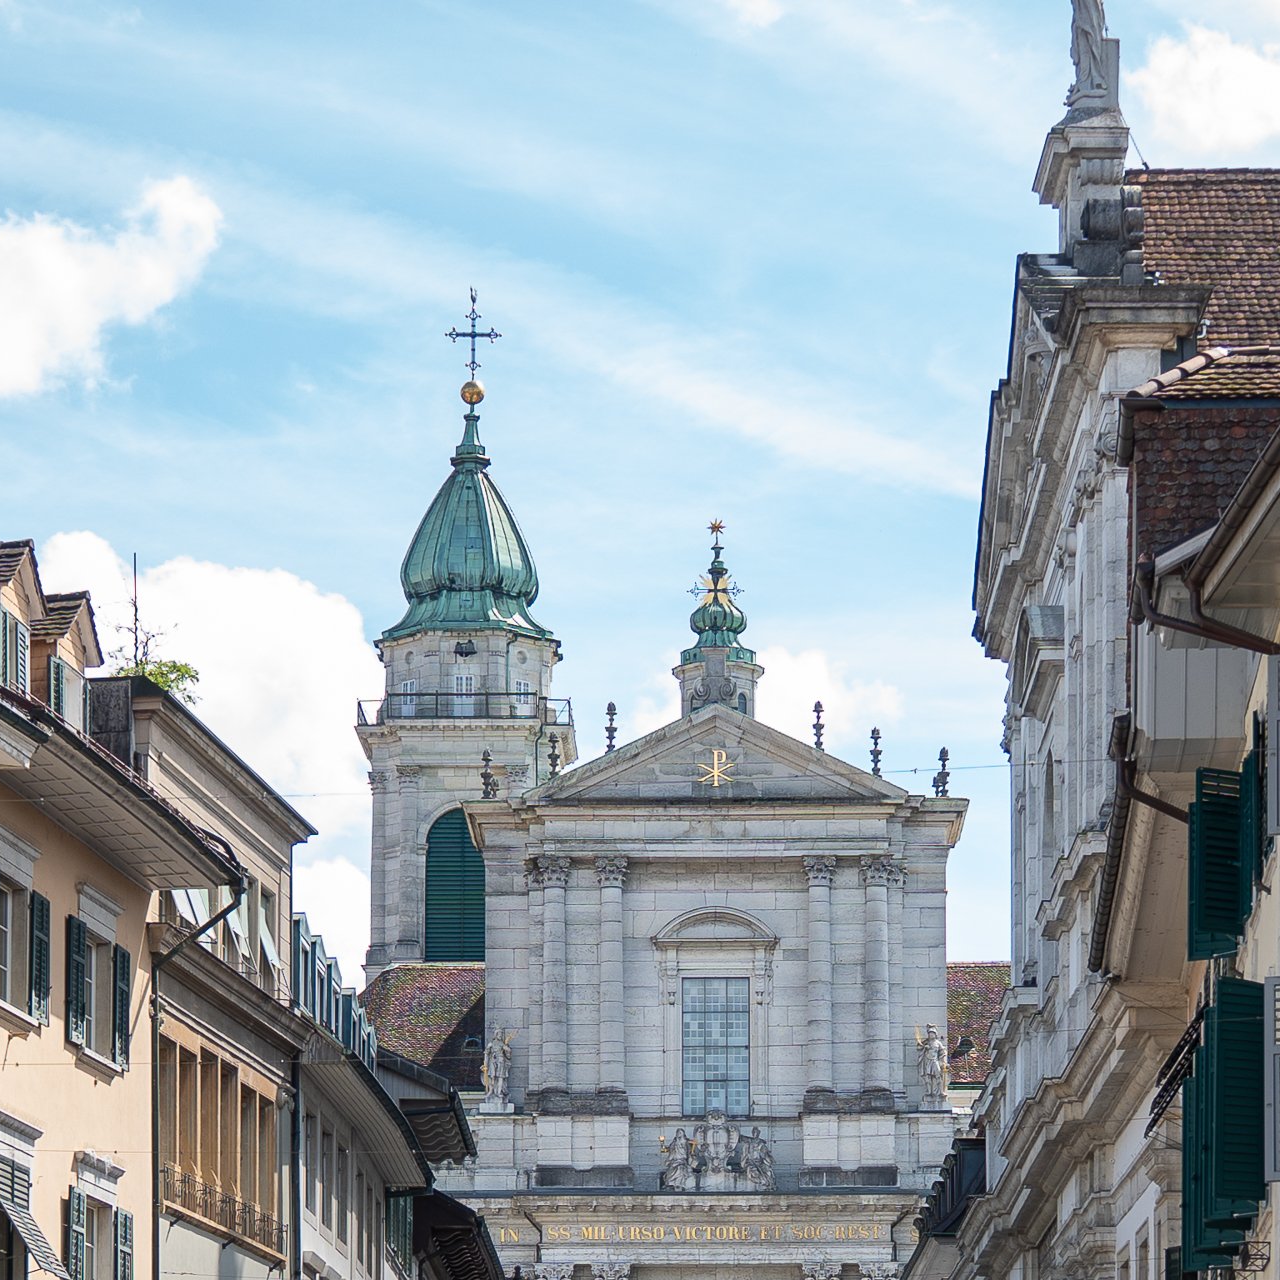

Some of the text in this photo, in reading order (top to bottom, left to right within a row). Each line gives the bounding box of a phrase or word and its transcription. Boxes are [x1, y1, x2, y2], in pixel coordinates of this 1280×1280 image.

[500, 1227, 519, 1242] IN
[674, 1226, 751, 1240] VICTORE
[760, 1226, 783, 1240] ET
